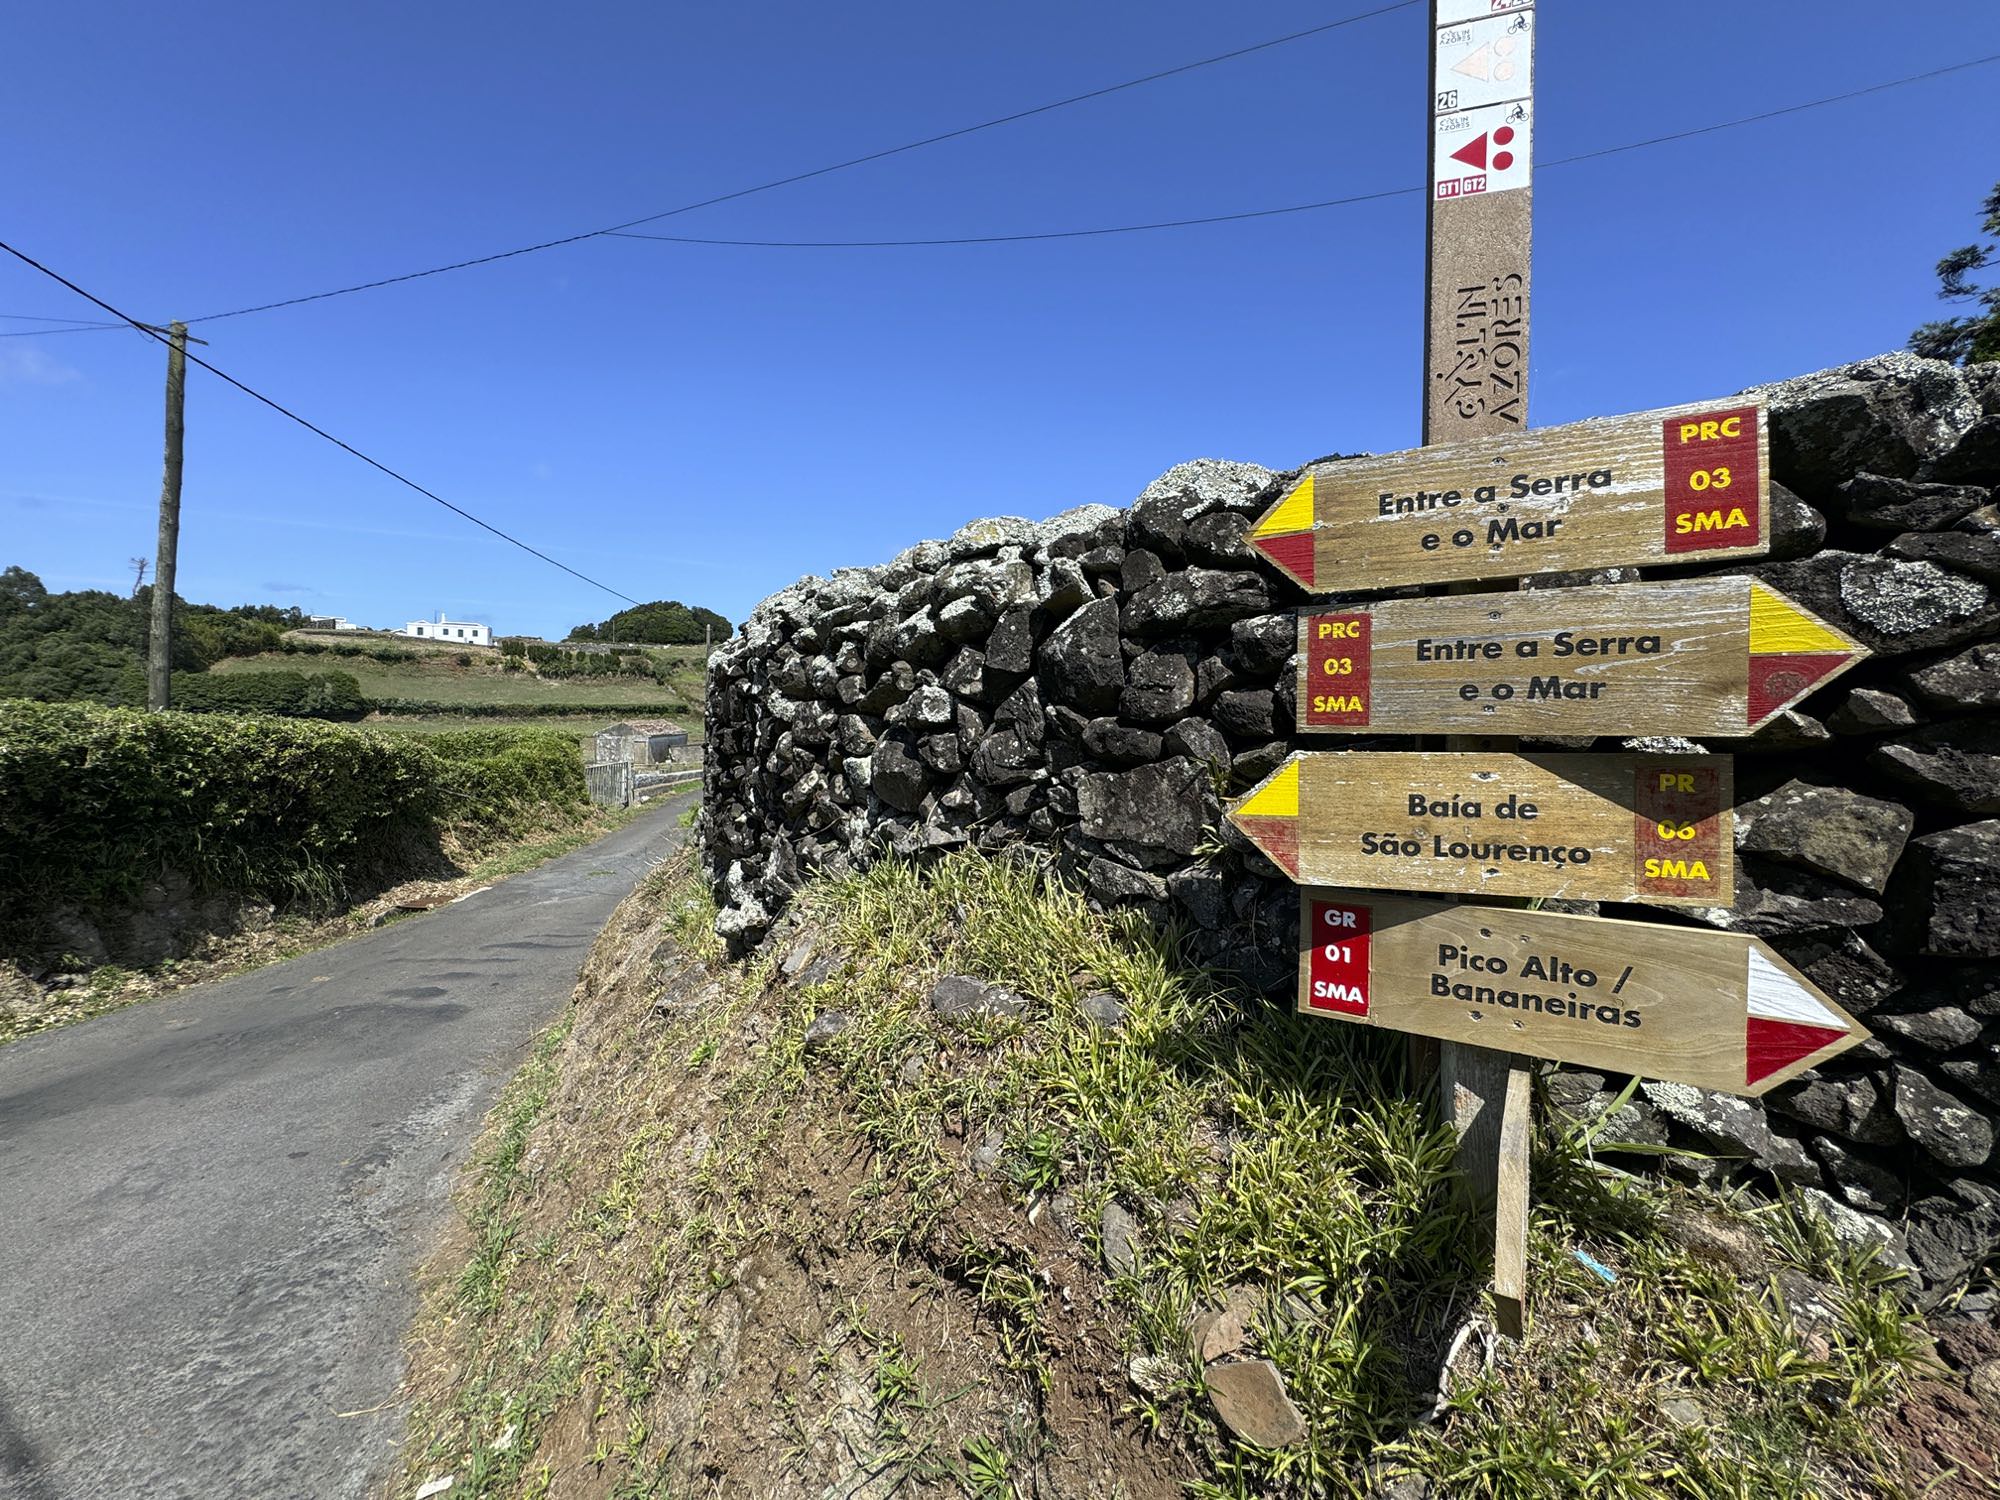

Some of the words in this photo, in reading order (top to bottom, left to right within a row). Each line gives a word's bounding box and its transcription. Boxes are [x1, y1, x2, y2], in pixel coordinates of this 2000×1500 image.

[1438, 91, 1457, 109] 26
[1438, 181, 1459, 198] GT1
[1463, 177, 1485, 192] GT2
[1489, 273, 1522, 423] AZORES
[1680, 416, 1741, 442] PRC
[1690, 467, 1732, 491] 03
[1379, 491, 1461, 516] Entre
[1474, 485, 1495, 503] a
[1510, 469, 1611, 498] Serra
[1676, 508, 1748, 533] SMA
[1421, 533, 1439, 551] e
[1452, 529, 1473, 546] o
[1486, 517, 1562, 543] Mar
[1318, 621, 1360, 639] PRC
[1417, 639, 1502, 661] Entre
[1516, 641, 1537, 657] a
[1553, 632, 1661, 656] Serra
[1323, 657, 1352, 675] 03
[1459, 684, 1479, 701] e
[1491, 683, 1514, 700] o
[1527, 676, 1607, 699] Mar
[1313, 695, 1364, 713] SMA
[1659, 773, 1696, 794] PR
[1408, 793, 1481, 817] Baía
[1494, 794, 1538, 819] de
[1657, 819, 1697, 841] 06
[1361, 832, 1422, 857] São
[1434, 835, 1590, 869] Lourenço
[1644, 859, 1711, 881] SMA
[1324, 910, 1356, 929] GR
[1325, 944, 1351, 963] 01
[1437, 943, 1507, 975] Pico
[1520, 956, 1597, 987] Alto
[1612, 967, 1633, 993] /
[1314, 981, 1365, 1004] SMA
[1431, 972, 1641, 1027] Bananeiras
